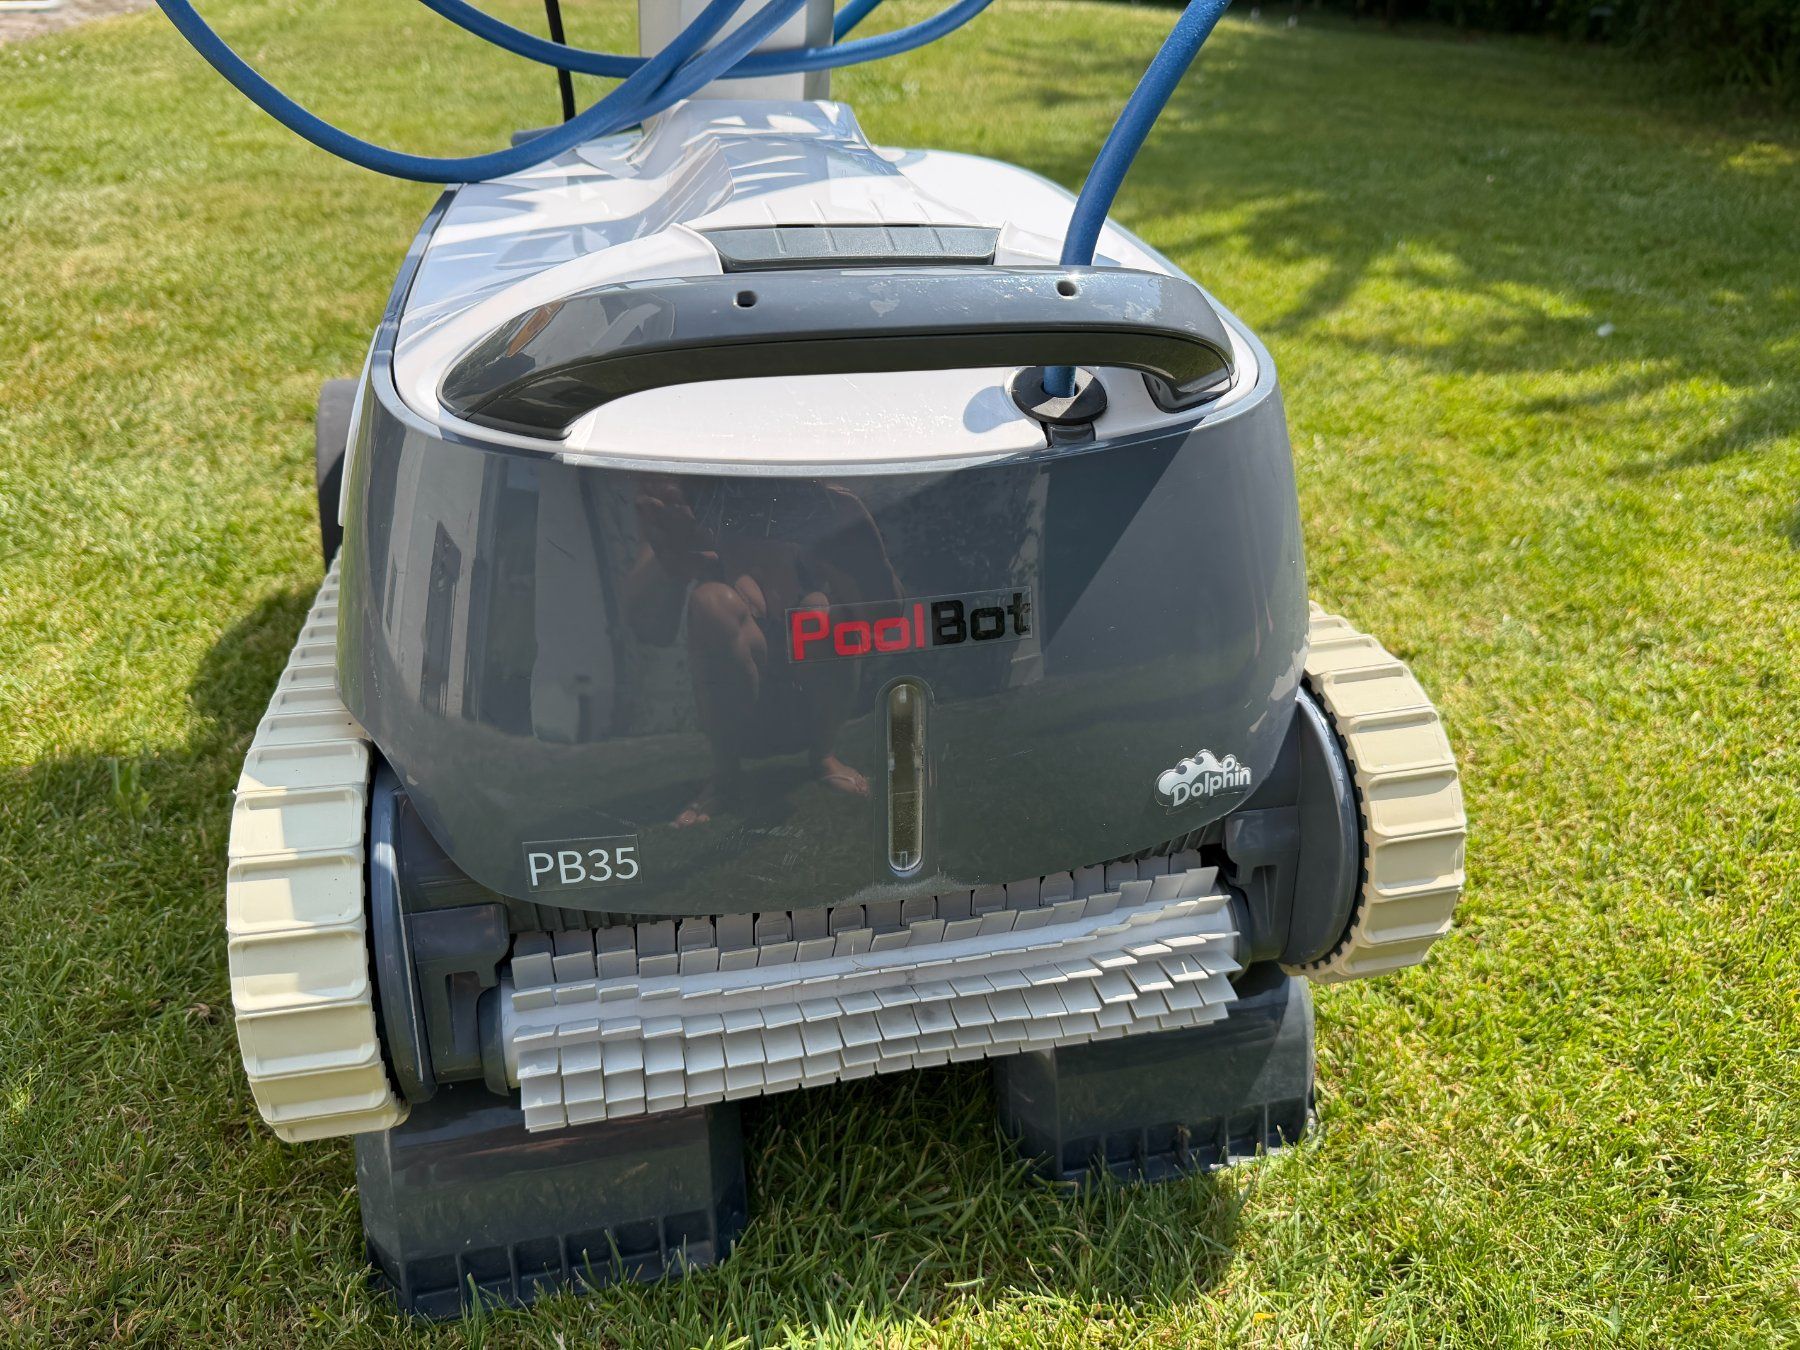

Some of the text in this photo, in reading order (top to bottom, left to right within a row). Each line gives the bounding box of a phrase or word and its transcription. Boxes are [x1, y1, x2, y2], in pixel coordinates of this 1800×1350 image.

[791, 593, 1032, 660] PoolBot
[1171, 756, 1252, 806] Dolphin
[528, 847, 639, 886] PB35
